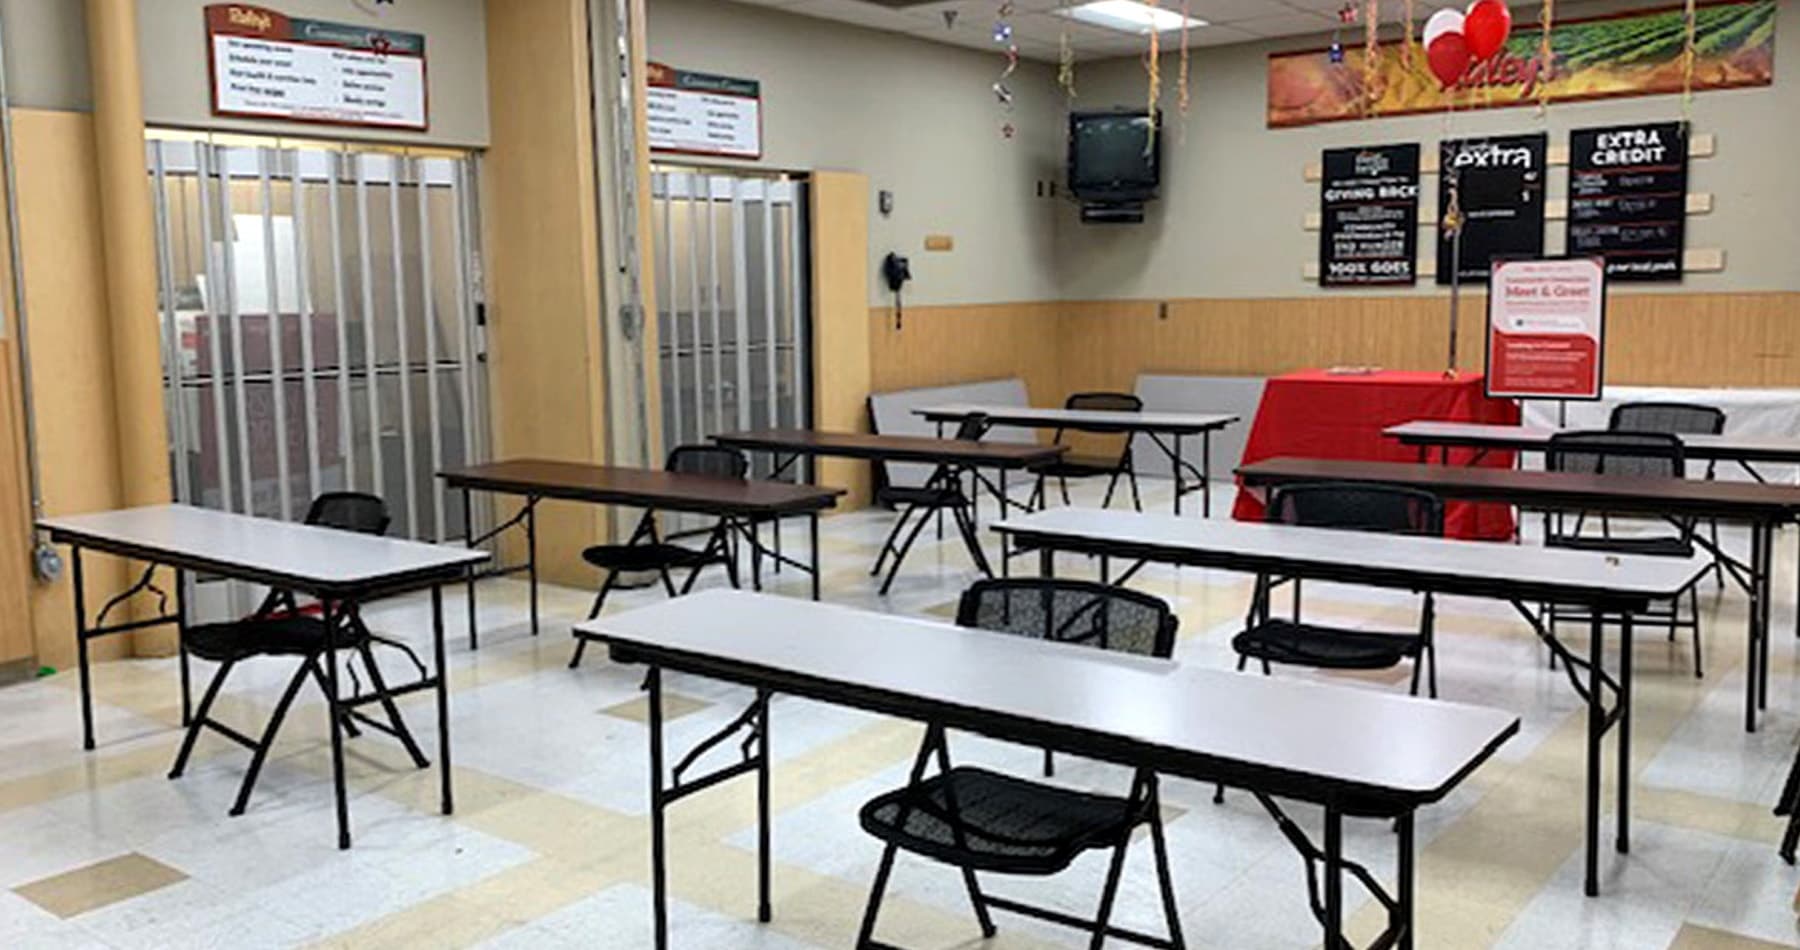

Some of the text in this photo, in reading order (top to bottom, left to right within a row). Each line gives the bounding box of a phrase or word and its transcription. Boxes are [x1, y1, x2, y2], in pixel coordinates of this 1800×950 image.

[1596, 129, 1661, 149] EXTRA
[1454, 144, 1531, 168] extra
[1591, 145, 1667, 165] CREDIT
[1379, 184, 1420, 198] BACK
